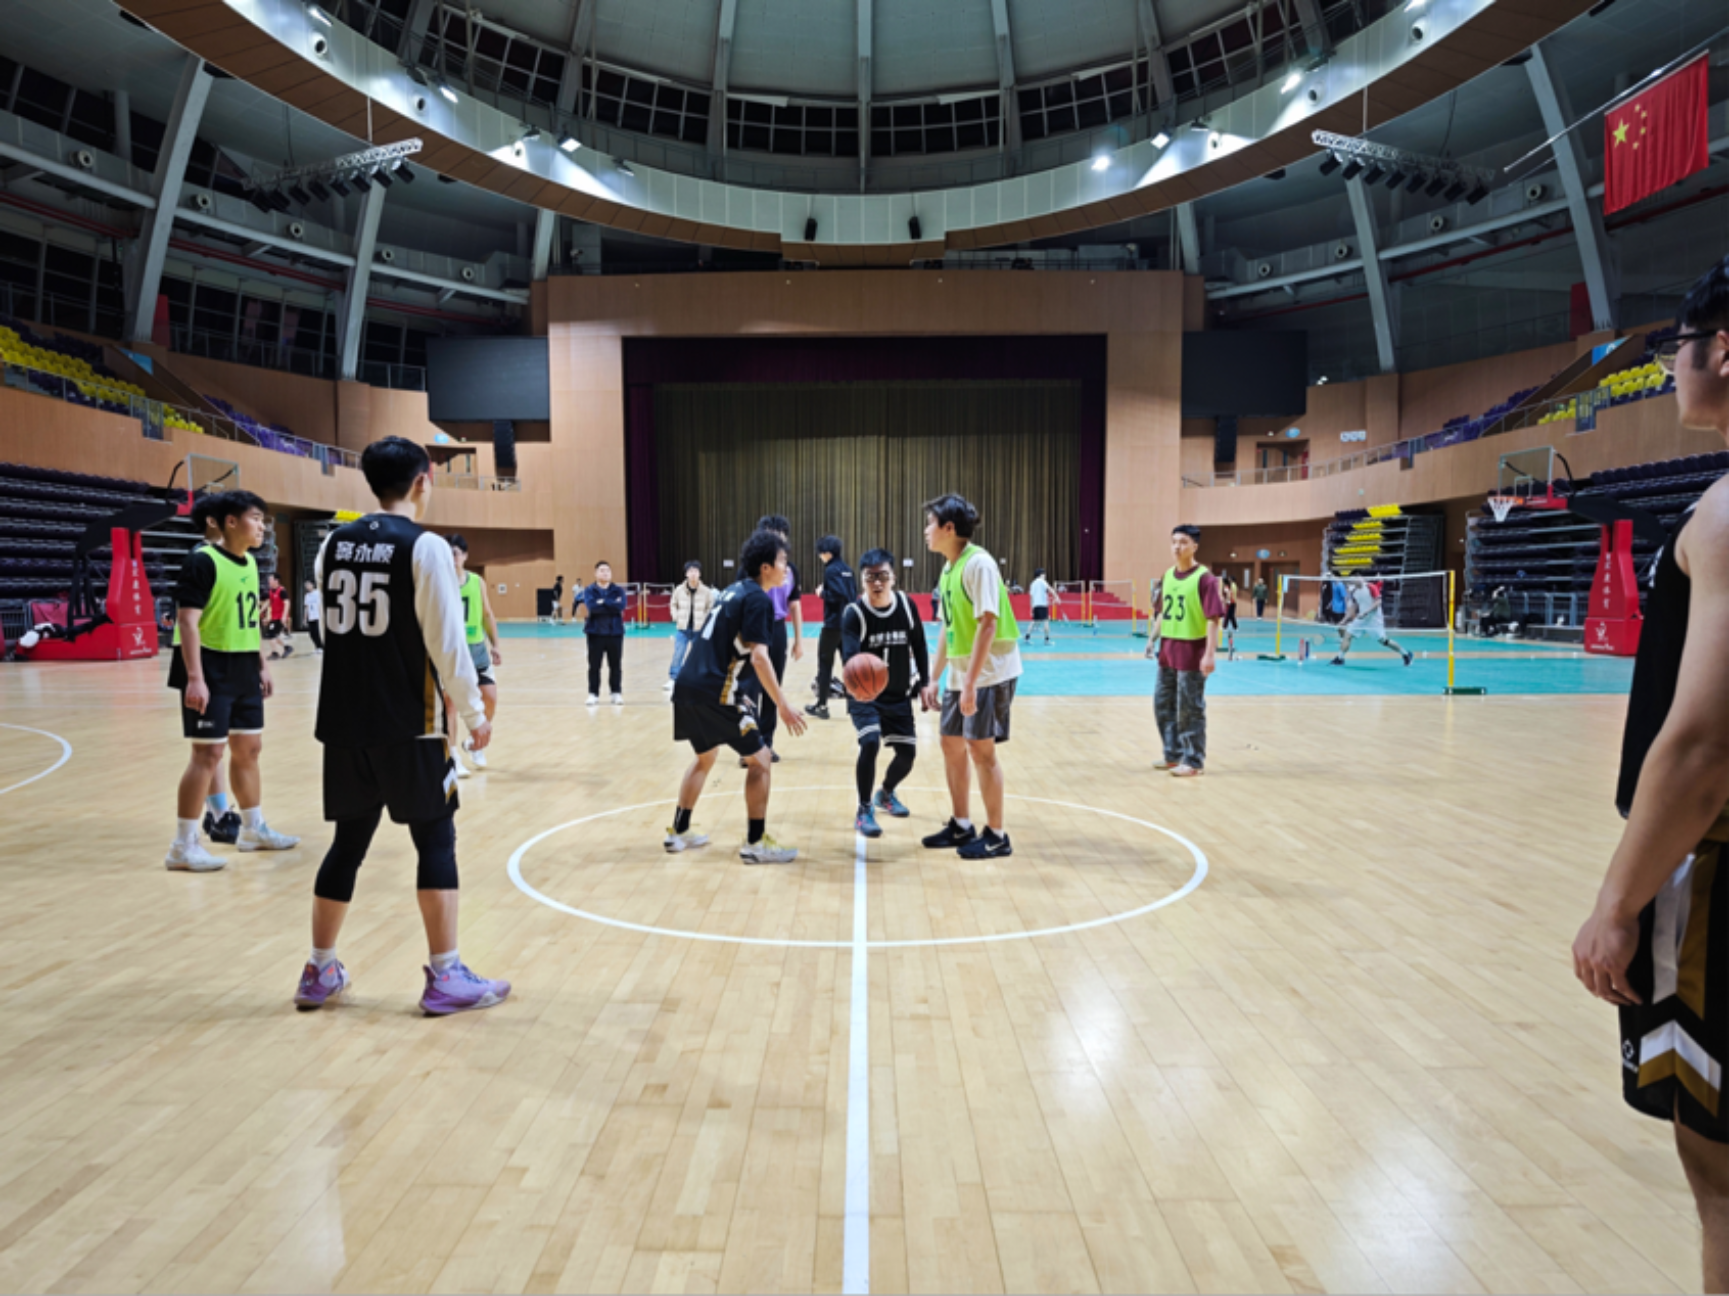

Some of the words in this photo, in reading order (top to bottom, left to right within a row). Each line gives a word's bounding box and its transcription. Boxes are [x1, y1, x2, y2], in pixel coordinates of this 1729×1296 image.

[236, 591, 257, 629] 12
[326, 569, 390, 636] 35
[1163, 594, 1186, 621] 23
